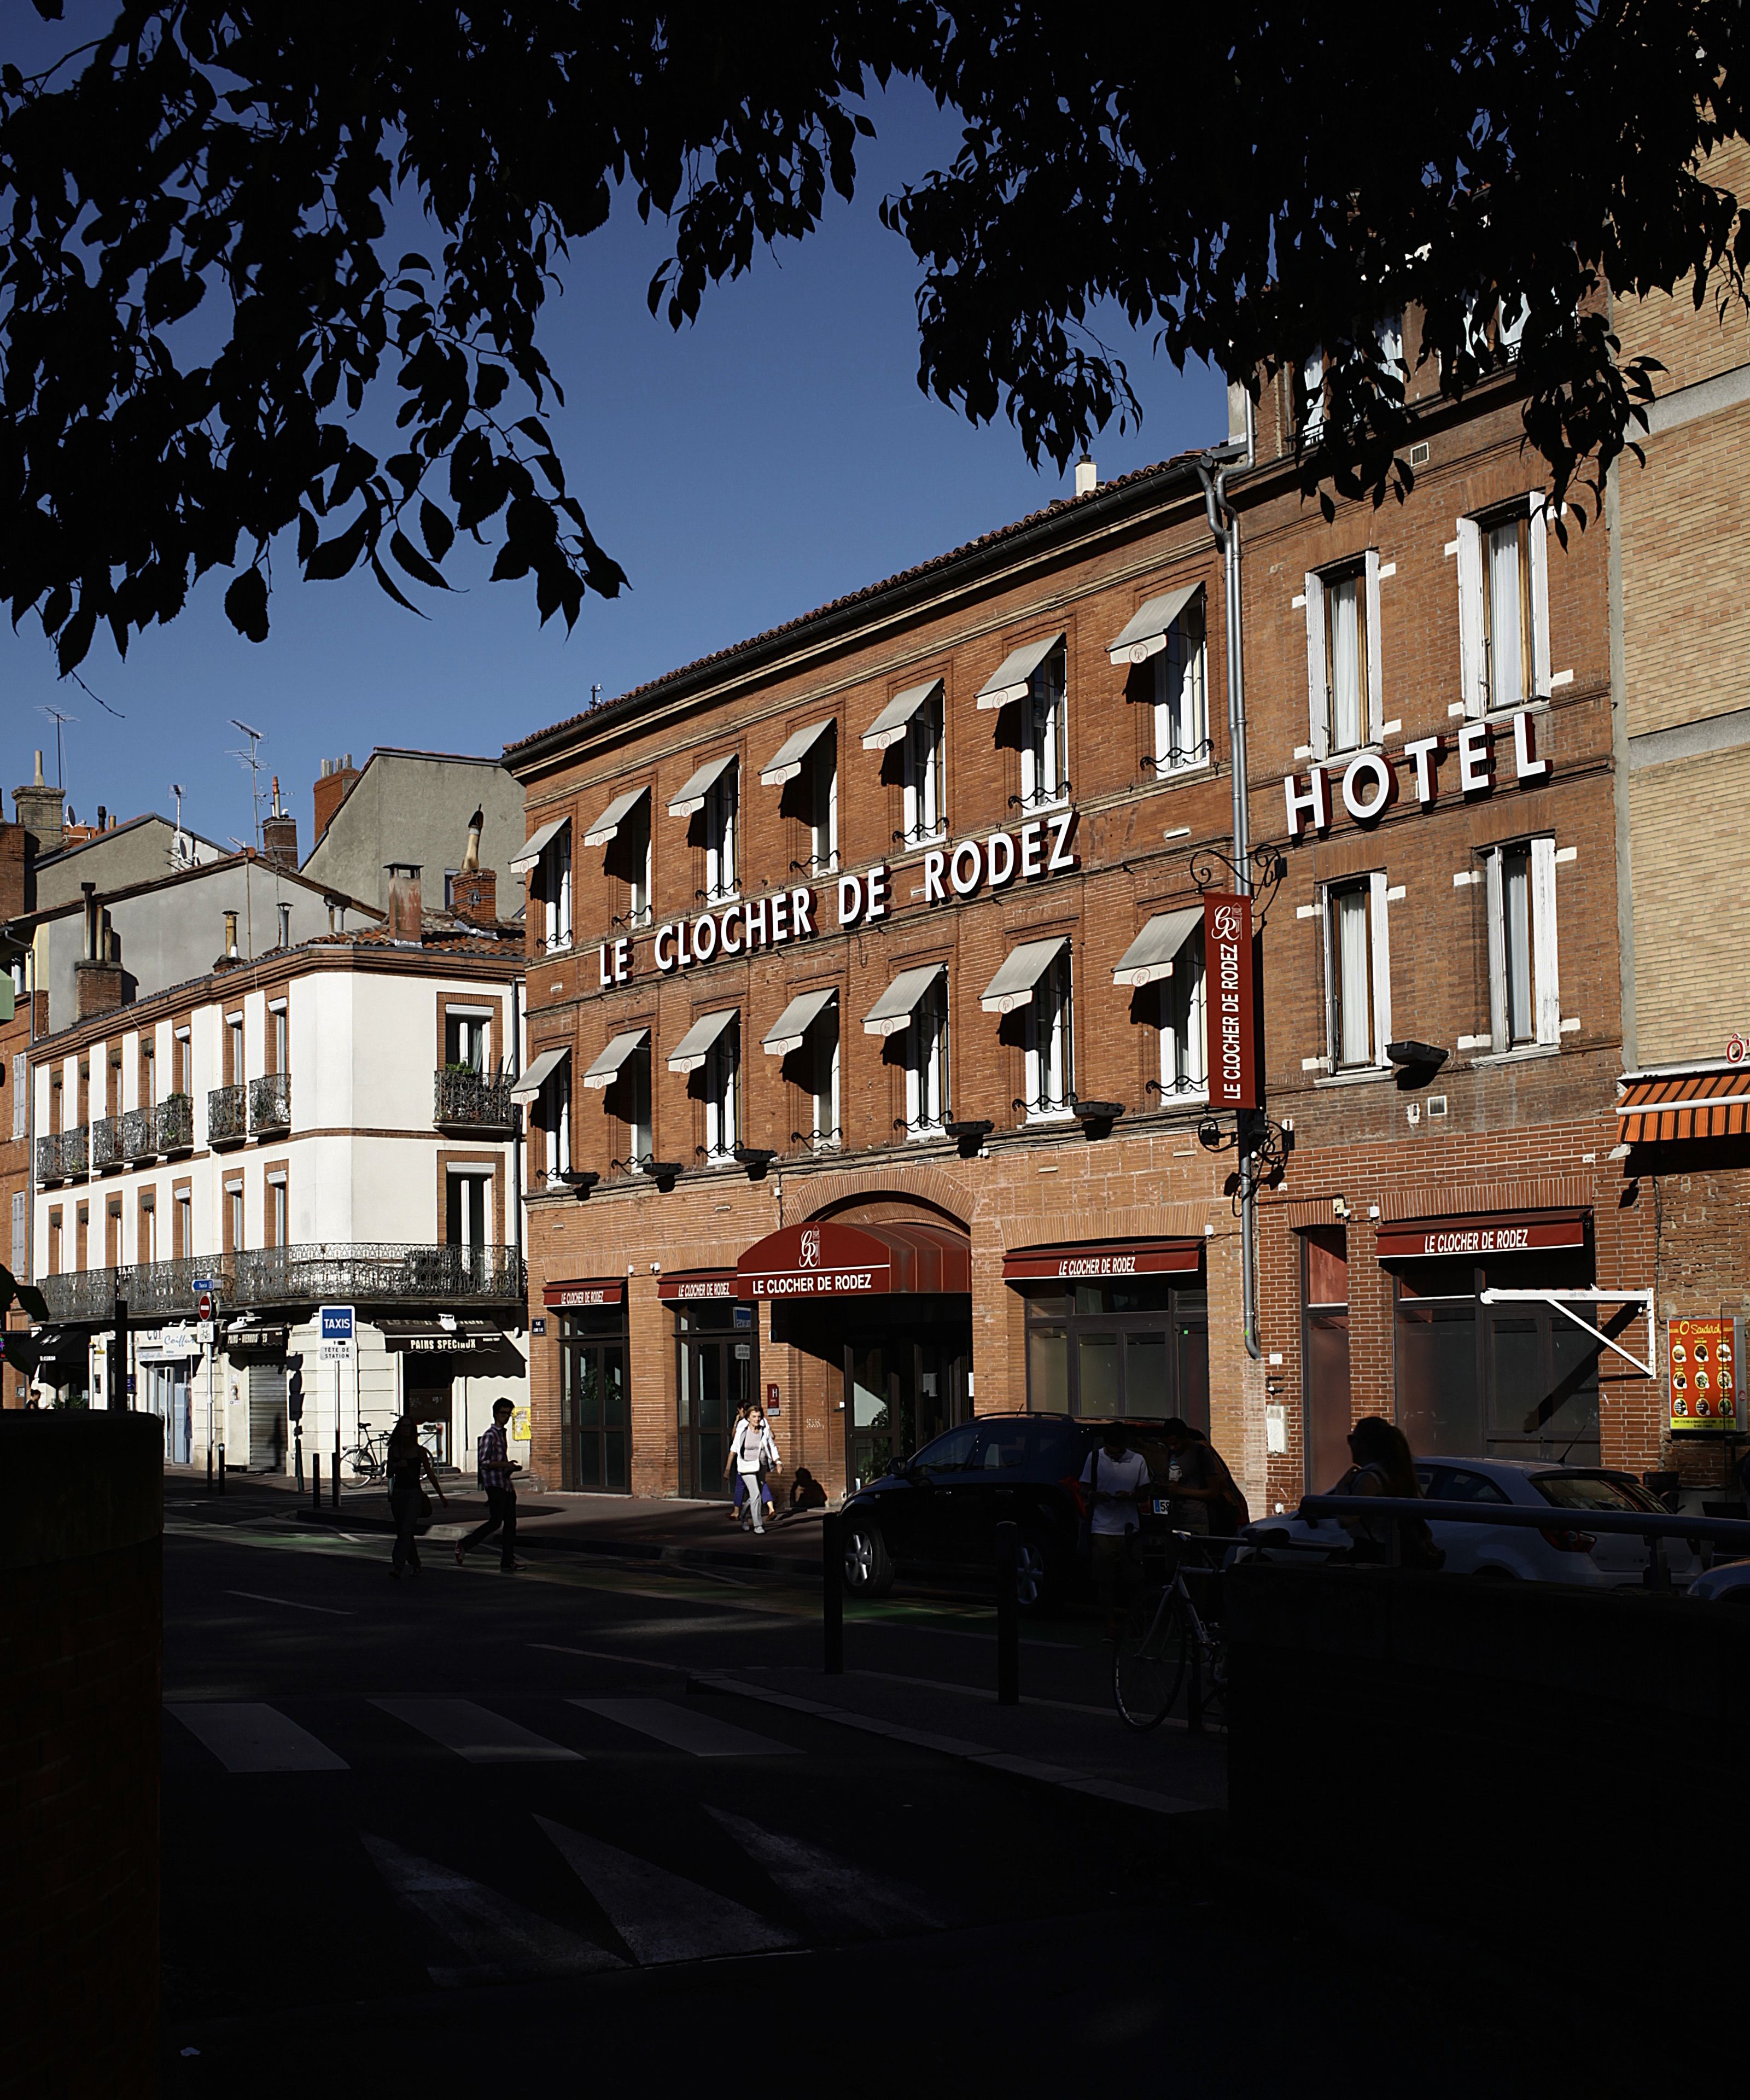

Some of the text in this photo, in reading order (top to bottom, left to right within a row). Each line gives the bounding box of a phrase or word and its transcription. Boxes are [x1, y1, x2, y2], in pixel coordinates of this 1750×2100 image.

[1285, 712, 1547, 835] HOTEL
[600, 812, 1074, 985] LE CLOCHER DE RODEZ
[1220, 943, 1241, 1099] LE CLOCHER DE RODEZ
[1425, 1229, 1529, 1253] LE CLOCHER DE RODEZ
[1058, 1257, 1136, 1275] LE CLOCHER DE RODEZ
[678, 1282, 730, 1297] LE CLOCHER DE RODEZ
[752, 1274, 872, 1294] LE CLOCHER DE RODEZ
[561, 1293, 567, 1304] LE
[585, 1291, 590, 1303] DE
[324, 1318, 351, 1329] TAXIS
[411, 1339, 434, 1350] PAINS
[772, 1389, 778, 1398] H
